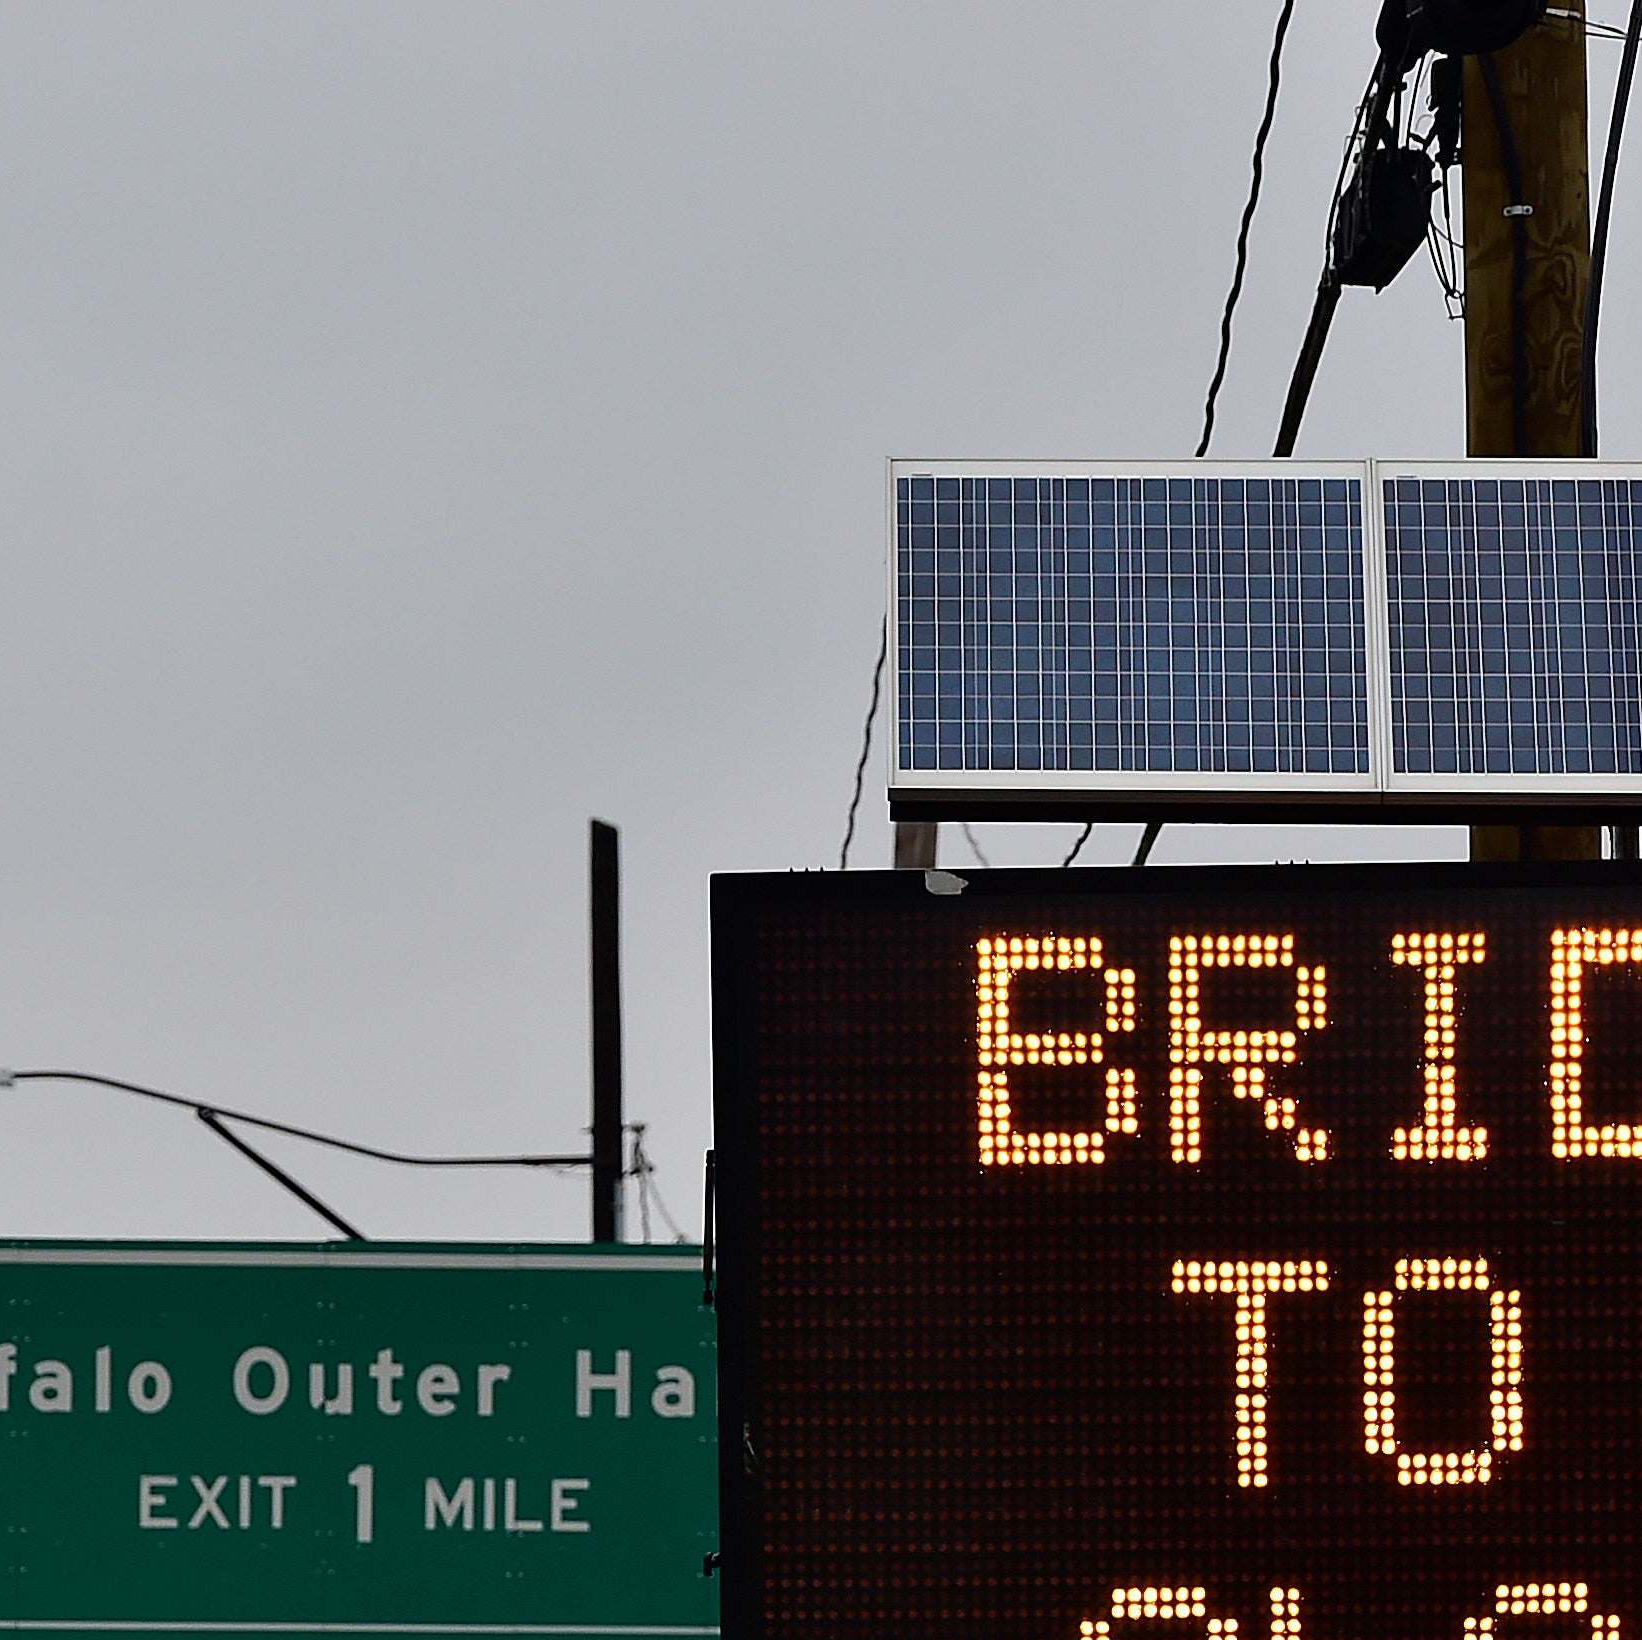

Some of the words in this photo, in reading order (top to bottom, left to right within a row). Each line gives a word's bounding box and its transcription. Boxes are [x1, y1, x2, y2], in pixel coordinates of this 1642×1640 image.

[234, 1346, 511, 1416] Outer
[576, 1349, 696, 1418] Ha
[1170, 1254, 1525, 1489] TO
[140, 1476, 298, 1530] EXIT
[348, 1465, 374, 1543] 1
[424, 1478, 591, 1533] MILE
